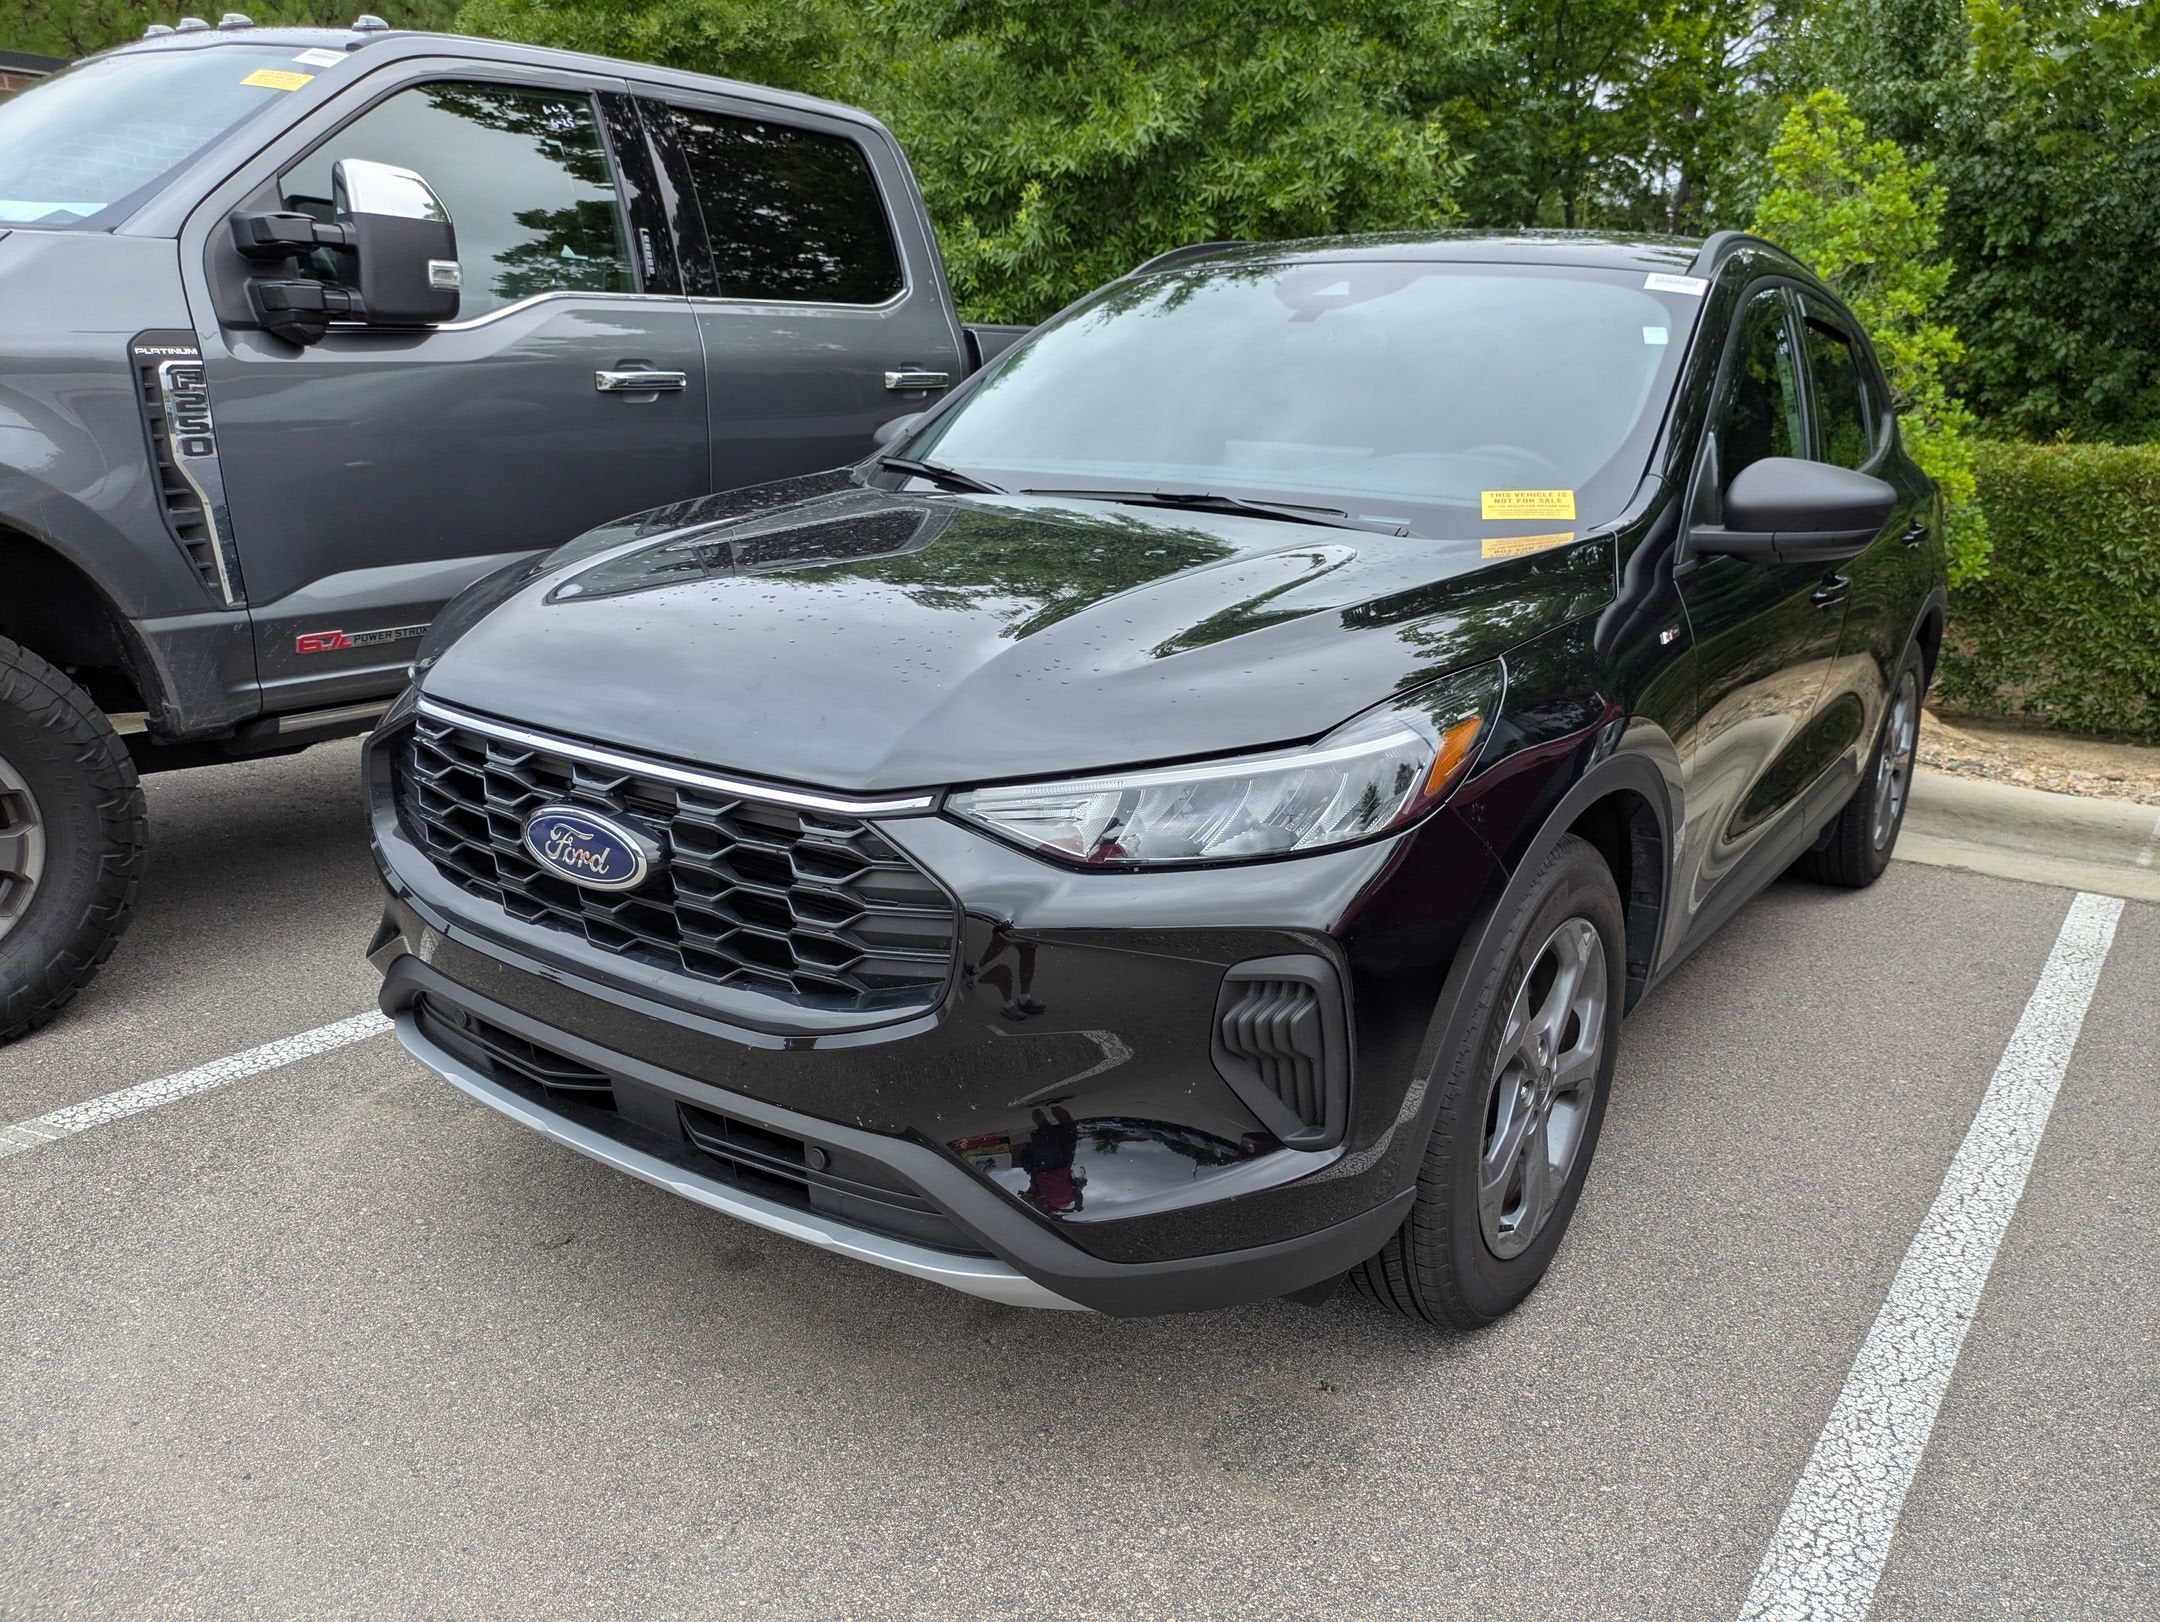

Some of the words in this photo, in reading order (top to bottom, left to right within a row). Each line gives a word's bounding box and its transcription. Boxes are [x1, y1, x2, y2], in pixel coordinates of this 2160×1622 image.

[134, 347, 198, 355] PLATINUM
[353, 630, 392, 643] POWER
[394, 625, 428, 638] STROK
[544, 823, 611, 875] Ford
